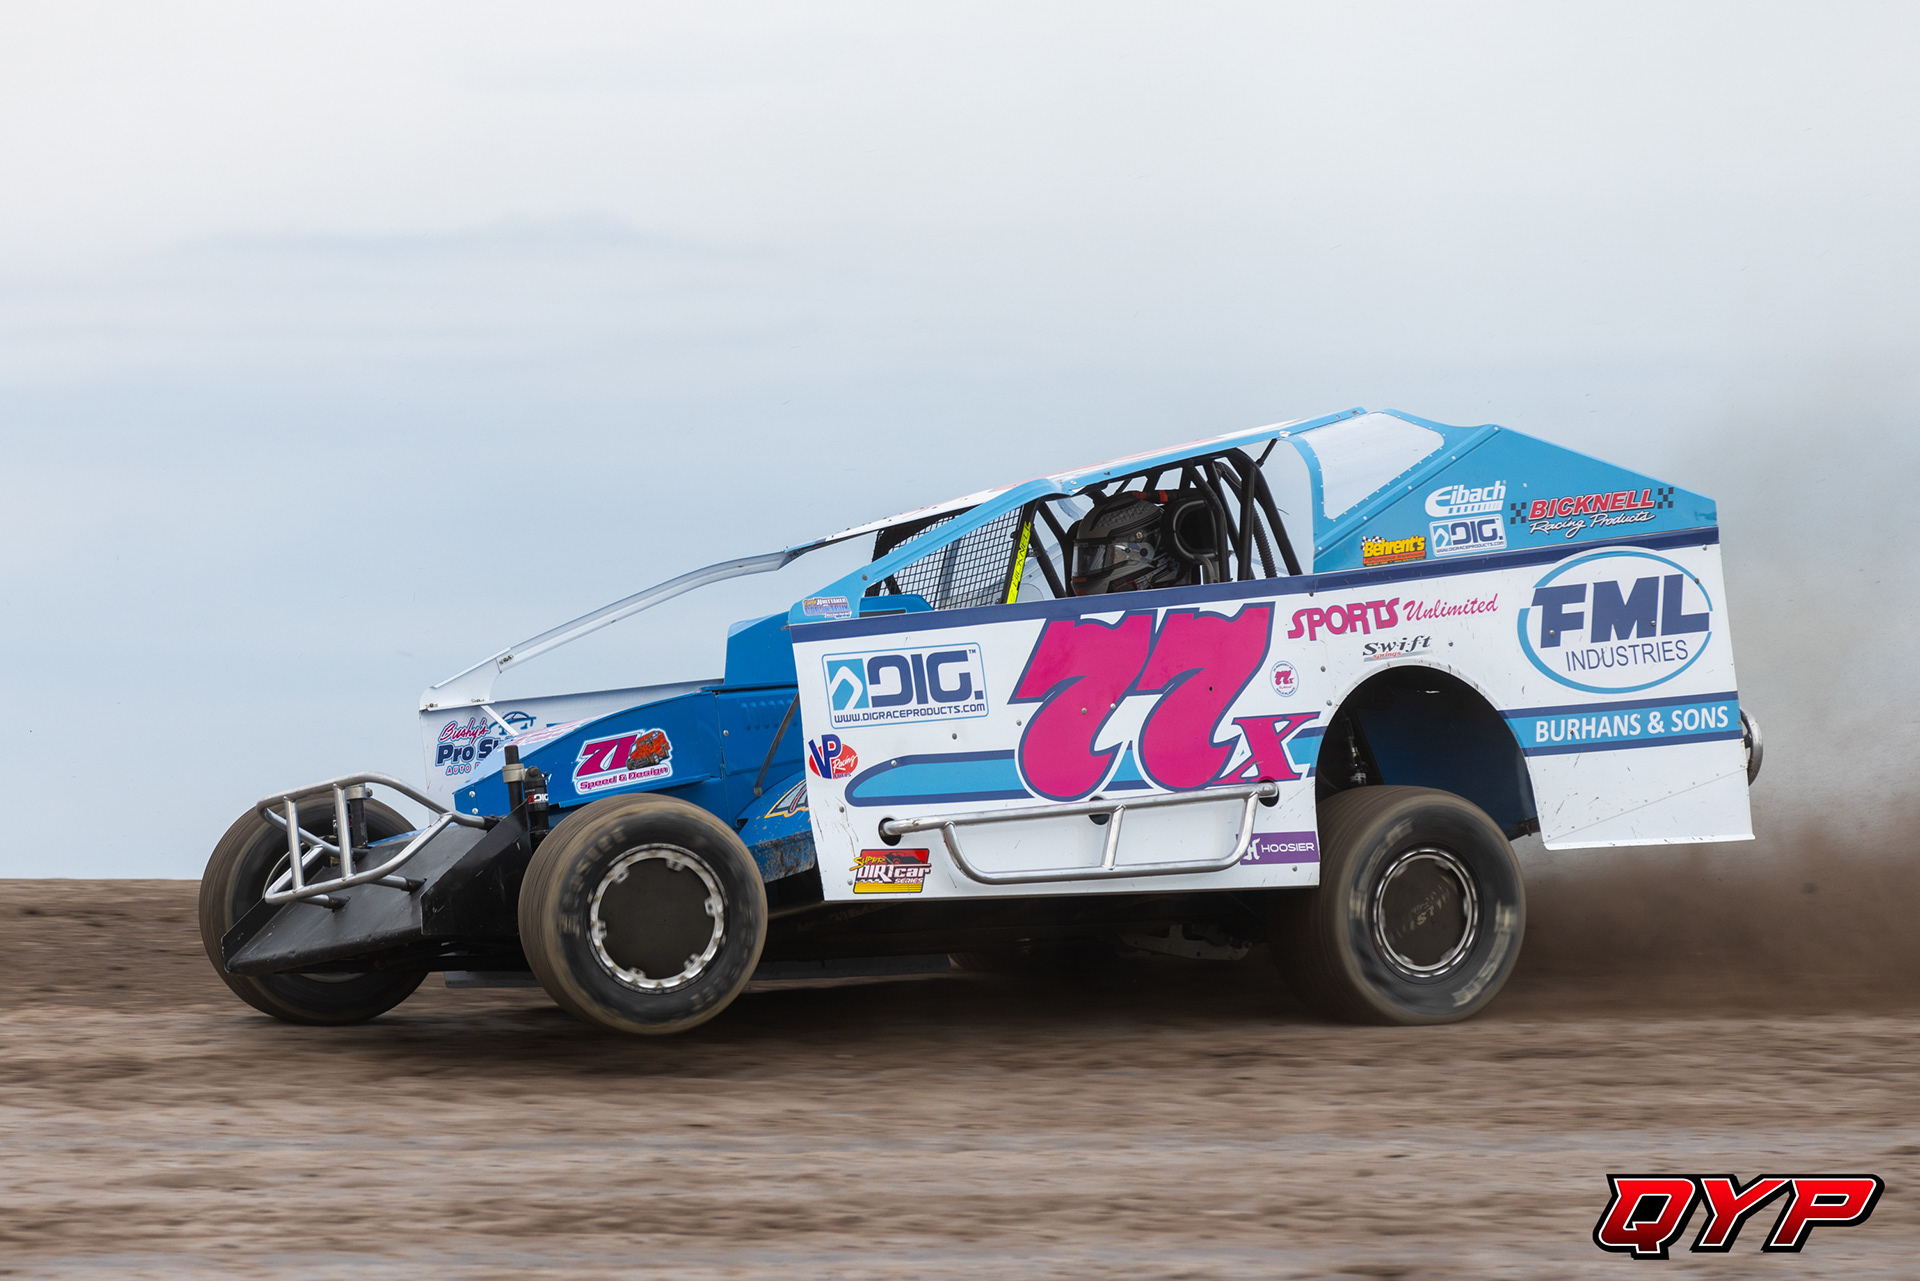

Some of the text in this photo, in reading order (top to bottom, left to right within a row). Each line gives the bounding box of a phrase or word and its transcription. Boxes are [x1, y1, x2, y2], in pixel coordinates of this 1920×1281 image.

[1425, 480, 1506, 517] Eibach
[1528, 489, 1656, 521] BICKNELL
[1529, 511, 1656, 539] Racing Products
[1363, 535, 1426, 558] Behrent's
[1288, 593, 1498, 641] SPORTS Unlimited
[1531, 574, 1710, 648] FML
[1565, 639, 1689, 672] INDUSTRIES
[834, 703, 986, 724] WWW.DIGRACEPRODUCTS.COM
[1535, 706, 1729, 743] BURHANS & SONS
[439, 718, 490, 744] Bushy's
[436, 744, 474, 765] Pro
[808, 734, 842, 779] VP
[832, 754, 858, 774] Racing
[447, 766, 471, 775] AUTO
[580, 776, 617, 790] Speed
[628, 767, 668, 781] Design
[1261, 842, 1315, 853] HOOSIER
